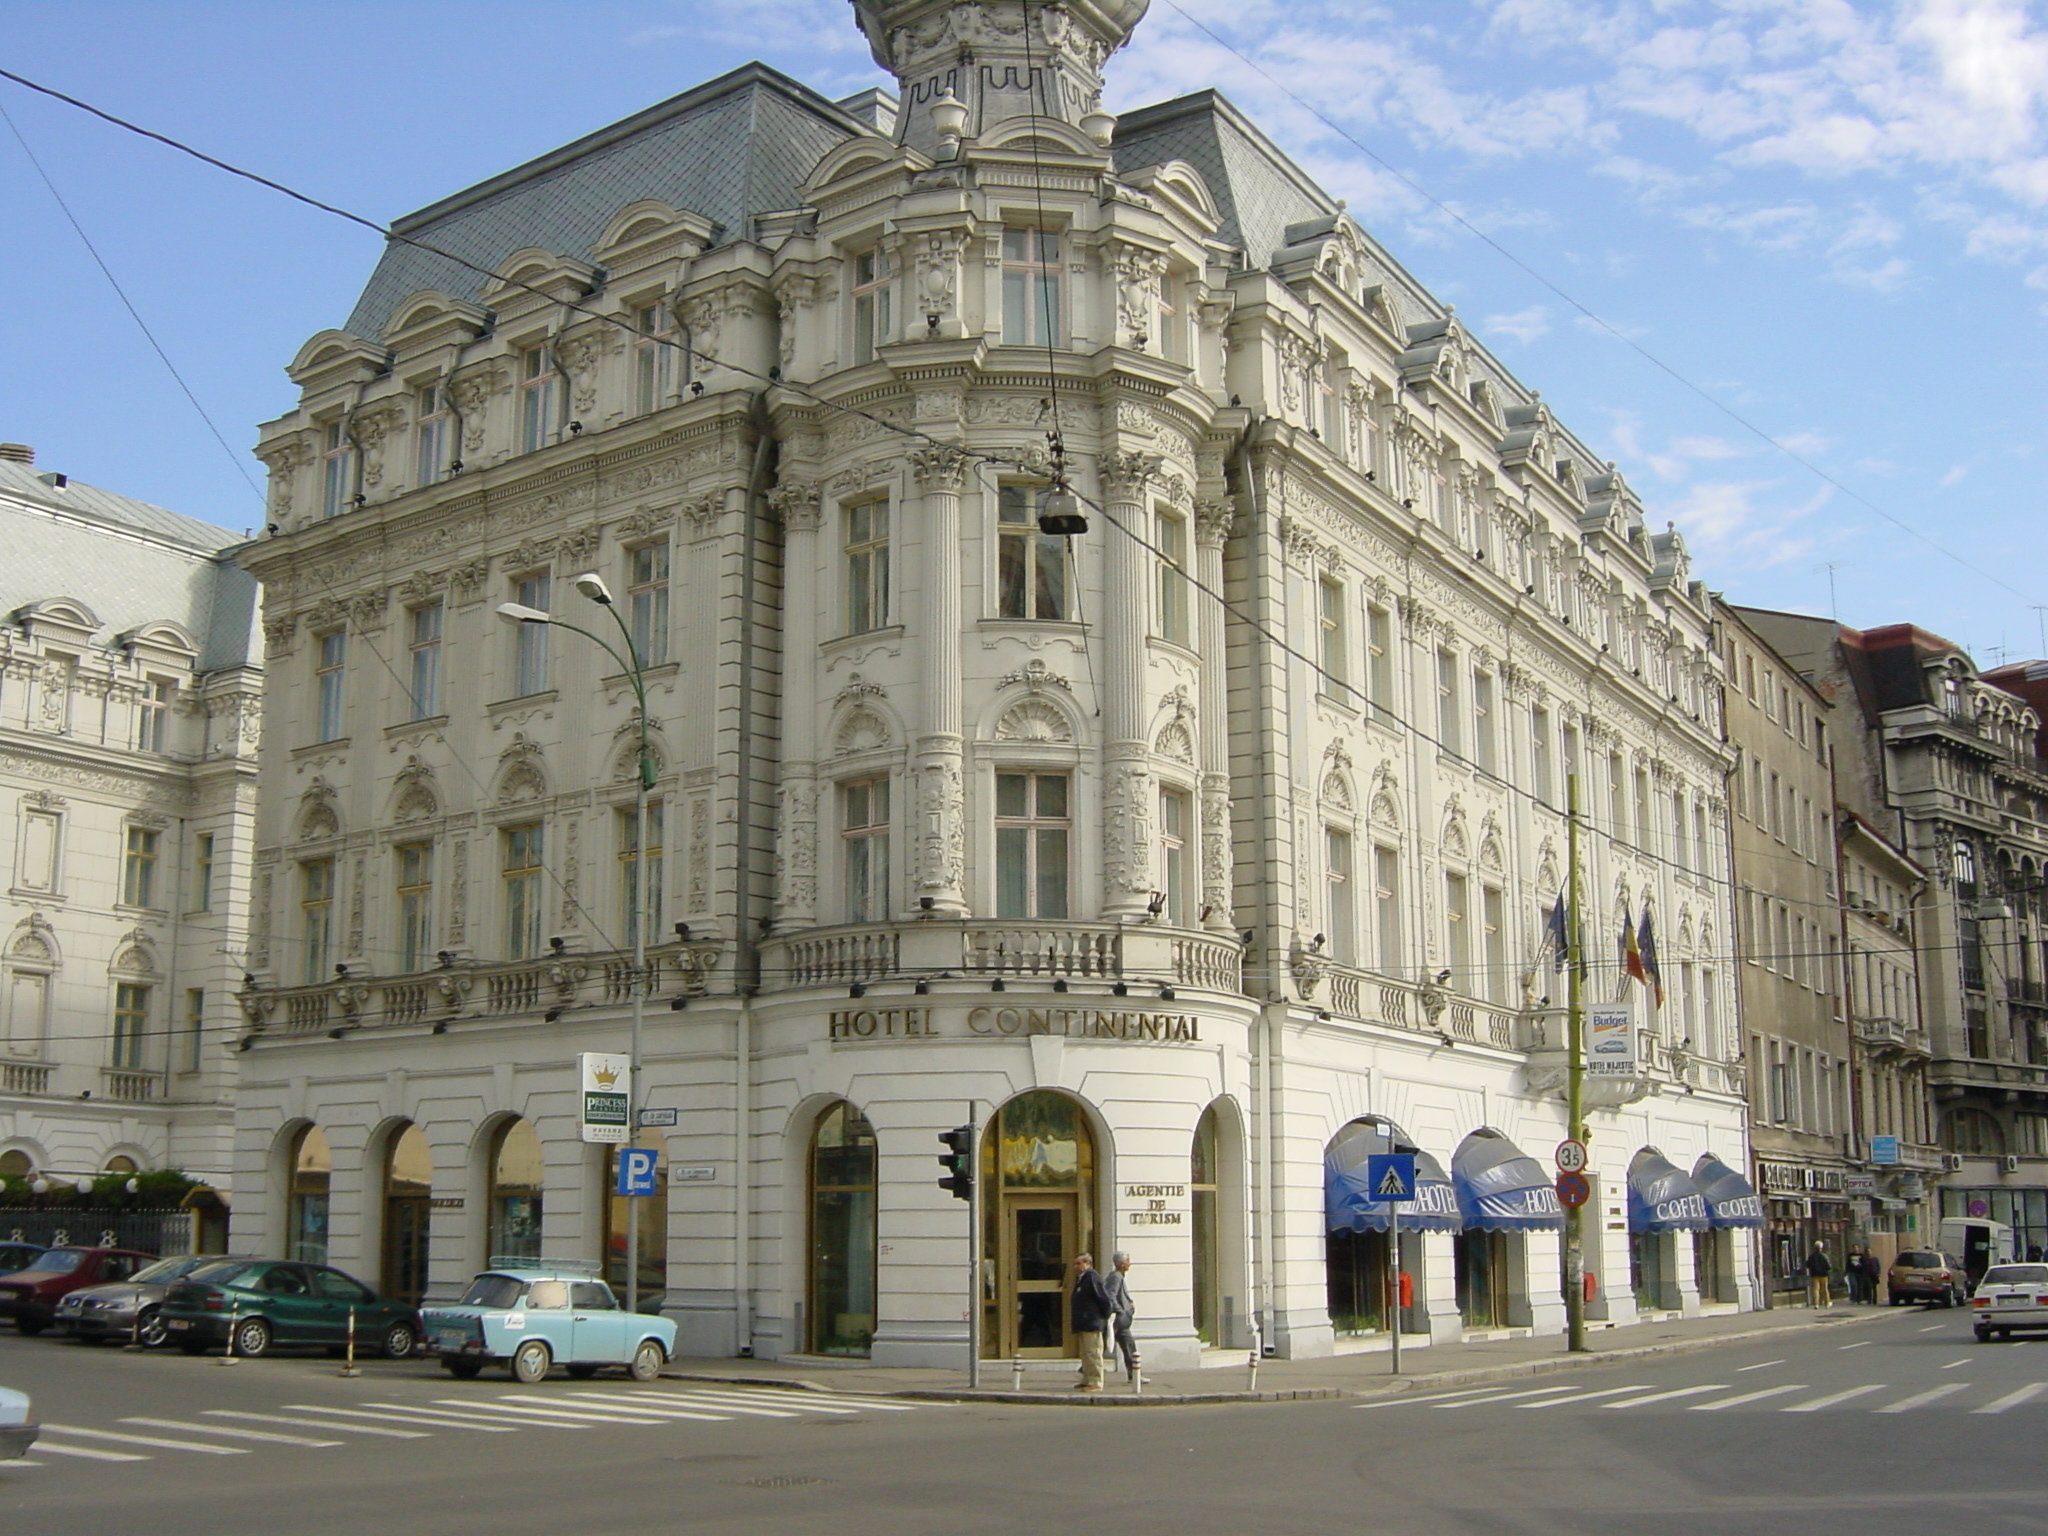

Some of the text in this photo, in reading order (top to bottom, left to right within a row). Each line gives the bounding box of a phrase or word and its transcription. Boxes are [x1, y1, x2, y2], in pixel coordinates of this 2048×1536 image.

[828, 1006, 1203, 1042] HOTEL CONTINENTAL
[1593, 1015, 1628, 1027] Budget
[587, 1097, 626, 1111] PRINCESS
[627, 1153, 650, 1190] P
[1148, 1199, 1166, 1212] DE
[1416, 1185, 1460, 1214] HOTEL
[1129, 1212, 1182, 1225] TURISM
